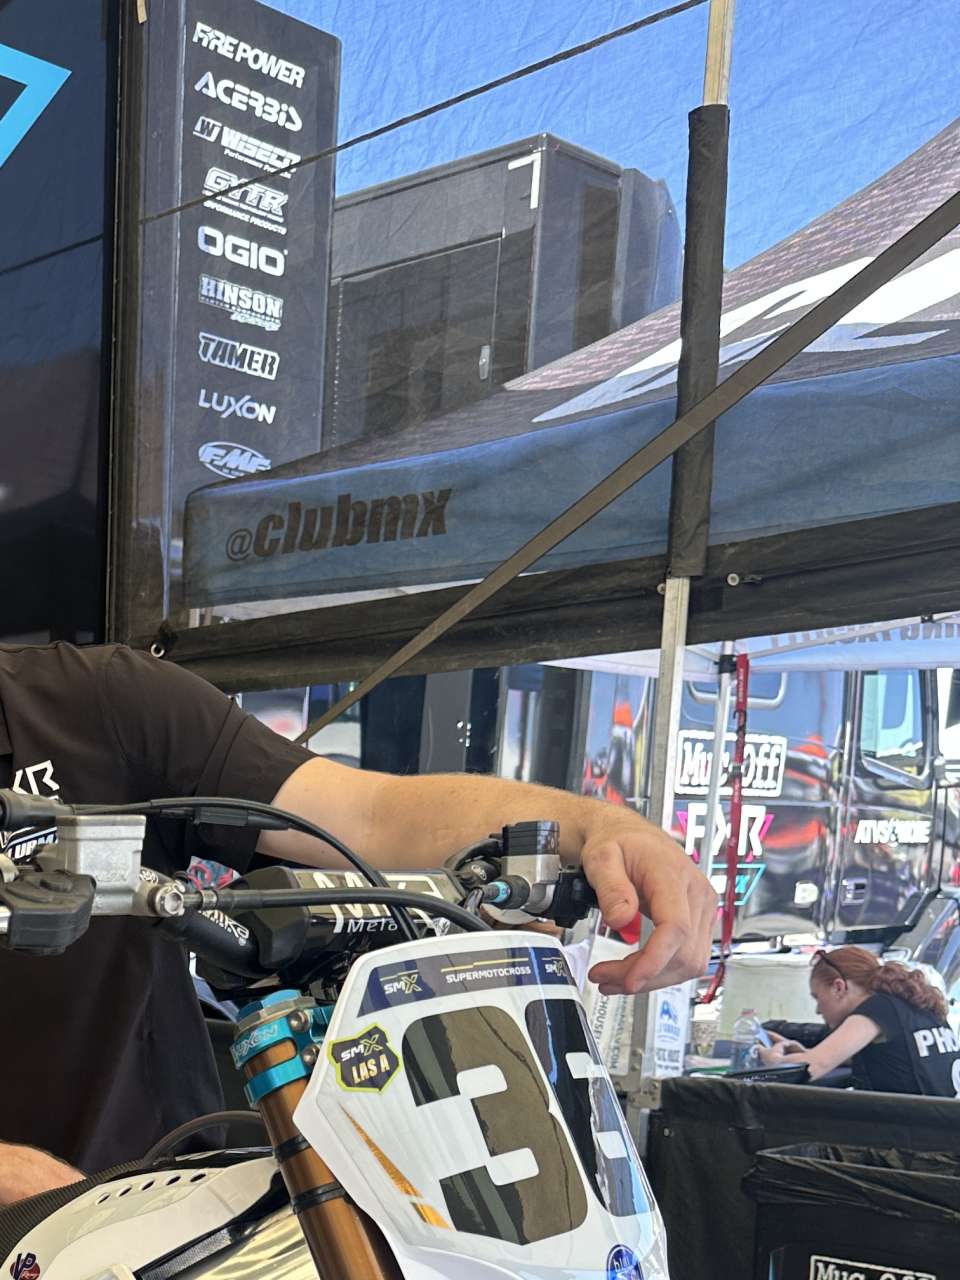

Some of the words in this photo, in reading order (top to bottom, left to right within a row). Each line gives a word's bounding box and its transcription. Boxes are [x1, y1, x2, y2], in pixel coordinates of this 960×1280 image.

[236, 42, 305, 89] POWER
[194, 71, 302, 131] ACERBIS
[198, 225, 285, 277] OGIO
[201, 276, 282, 318] HINSON
[199, 332, 280, 380] TAMER
[198, 388, 276, 424] LUXON
[225, 488, 453, 562] @clubmx
[384, 974, 422, 995] SMX
[445, 965, 531, 985] SUPERMOTOCROSS
[341, 1034, 384, 1062] SMX
